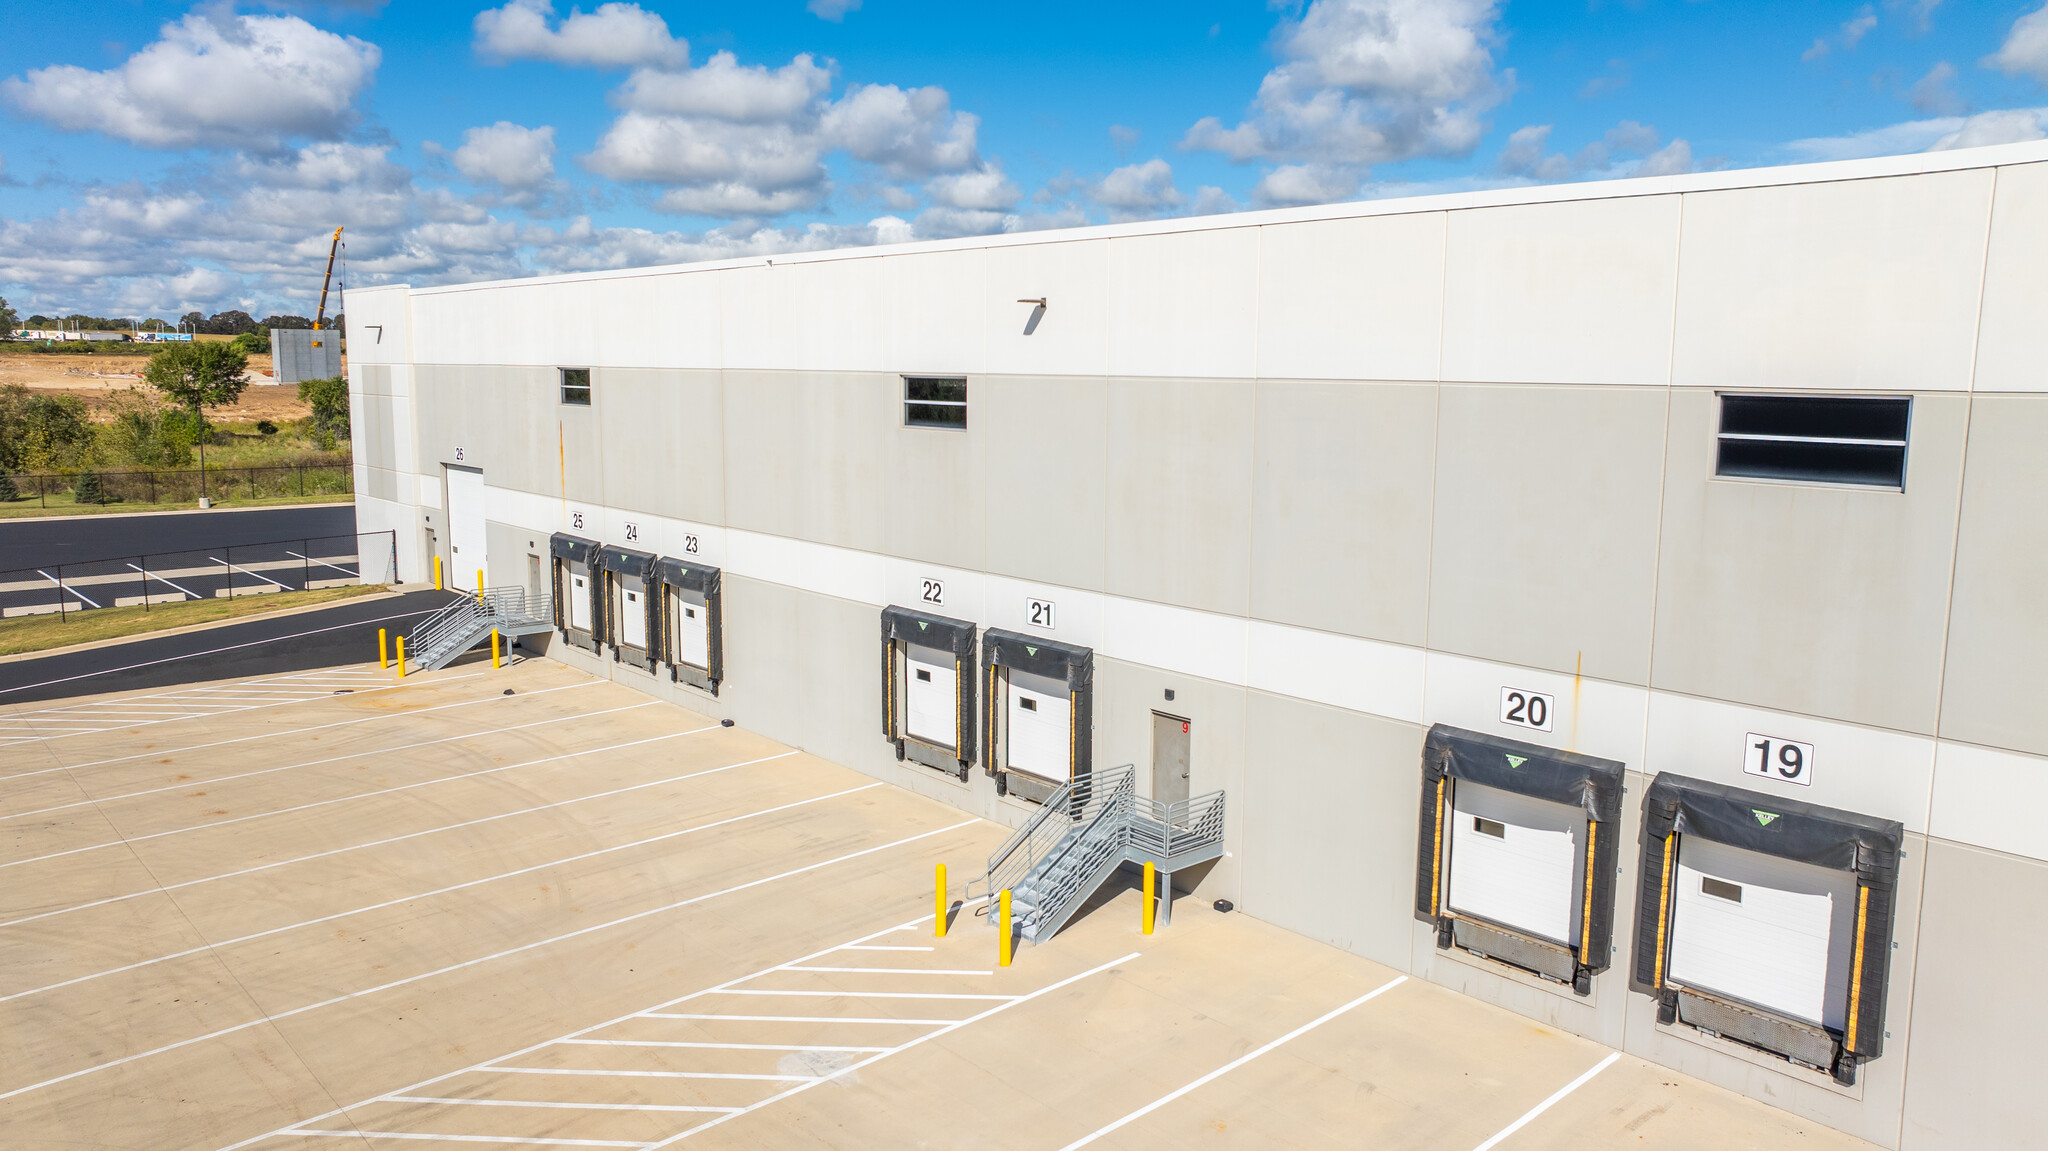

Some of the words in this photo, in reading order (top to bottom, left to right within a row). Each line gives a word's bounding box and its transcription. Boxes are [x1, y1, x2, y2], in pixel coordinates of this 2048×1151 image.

[455, 447, 464, 461] 26
[573, 513, 584, 529] 25
[626, 524, 638, 541] 24
[685, 535, 698, 553] 23
[923, 580, 942, 604] 22
[1031, 601, 1051, 626] 21
[1506, 692, 1546, 726] 20
[1182, 722, 1189, 734] 9
[1754, 740, 1803, 778] 19
